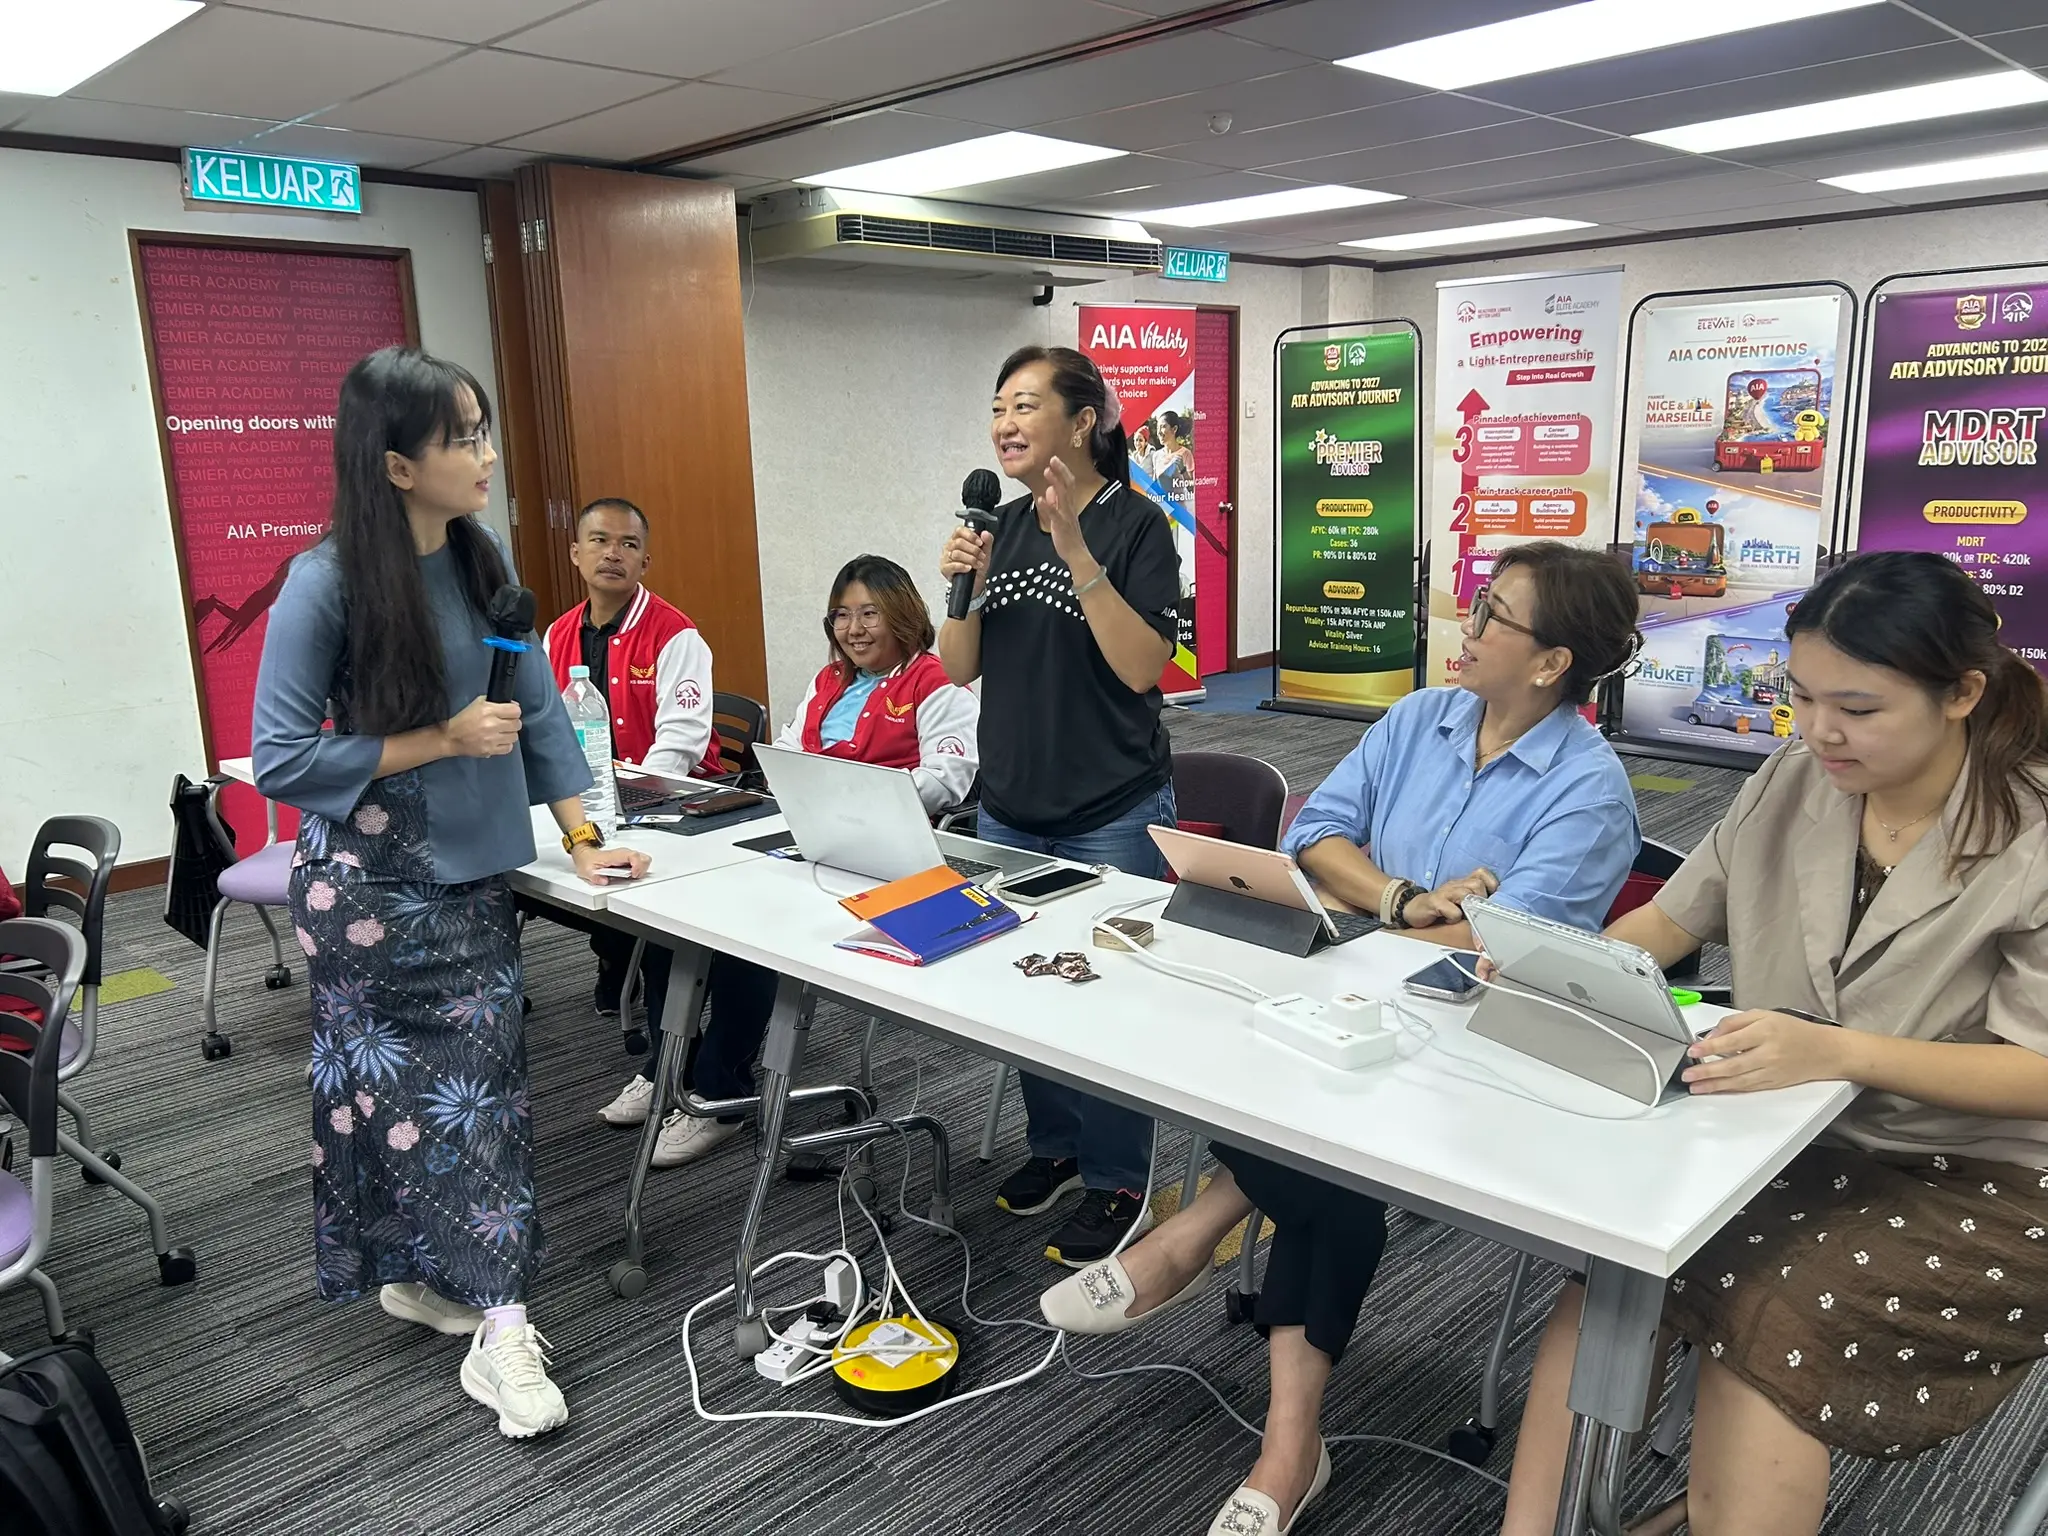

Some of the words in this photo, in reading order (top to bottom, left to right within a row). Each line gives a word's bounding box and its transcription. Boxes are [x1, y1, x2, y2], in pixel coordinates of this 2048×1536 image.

[195, 155, 324, 204] KELUAR
[202, 249, 277, 264] ACADEMY
[1167, 251, 1216, 278] KELUAR
[206, 276, 281, 292] ACADEMY
[290, 281, 355, 295] PREMIER
[1556, 295, 1572, 303] AIA
[1962, 300, 1981, 309] AIA
[1556, 302, 1571, 311] ELITE
[1572, 300, 1600, 310] ACADEMY
[210, 304, 284, 319] ACADEMY
[293, 308, 358, 321] PREMIER
[2003, 311, 2030, 323] AIA
[1697, 317, 1735, 331] ELEVATE
[214, 332, 287, 346] ACADEMY
[296, 334, 361, 348] PREMIER
[1090, 324, 1137, 349] AIA
[1140, 321, 1189, 358] Vitality
[1470, 324, 1583, 348] Empowering
[1726, 335, 1747, 344] 2026
[1668, 349, 1694, 363] AIA
[1697, 342, 1808, 361] CONVENTIONS
[1927, 343, 2000, 358] ADVANCING
[2002, 340, 2019, 353] TO
[2022, 338, 2048, 352] 202
[1457, 359, 1464, 367] a
[1469, 350, 1594, 368] Light-Entrepreneurship
[217, 360, 291, 373] ACADEMY
[1097, 365, 1118, 374] tively
[1119, 364, 1153, 375] supports
[1154, 364, 1169, 373] and
[1889, 361, 1922, 379] AIA
[1922, 357, 2010, 378] ADVISORY
[2011, 354, 2048, 374] JOU
[1122, 378, 1136, 388] you
[1137, 376, 1147, 385] for
[1149, 376, 1177, 387] making
[1516, 374, 1531, 382] Step
[1545, 372, 1559, 380] Real
[1561, 371, 1584, 379] Growth
[1311, 380, 1350, 391] ADVANCING
[1351, 379, 1361, 389] TO
[1362, 377, 1380, 388] 2027
[1750, 383, 1765, 392] AIA
[221, 387, 295, 400] ACADEMY
[1119, 388, 1148, 398] choices
[1291, 394, 1309, 408] AIA
[1309, 391, 1356, 407] ADVISORY
[1357, 388, 1401, 404] JOURNEY
[1646, 400, 1675, 412] NICE
[1677, 402, 1684, 410] &
[1474, 414, 1510, 424] Pinnacle
[1512, 414, 1521, 423] of
[1524, 412, 1580, 422] achievement
[1645, 411, 1713, 424] MARSEILLE
[166, 416, 244, 433] Opening
[249, 416, 299, 430] doors
[1924, 408, 2045, 442] MDRT
[229, 440, 301, 452] ACADEMY
[1453, 426, 1473, 462] 3
[1317, 441, 1382, 464] PREMIER
[1918, 440, 2038, 466] ADVISOR
[233, 467, 304, 479] ACADEMY
[1331, 464, 1370, 476] ADVISOR
[1172, 478, 1194, 488] Know
[1195, 476, 1218, 487] cademy
[1168, 491, 1195, 502] Health
[1474, 486, 1520, 496] Twin-track
[1521, 488, 1551, 496] career
[1552, 486, 1573, 497] path
[236, 493, 307, 506] ACADEMY
[1321, 503, 1368, 512] PRODUCTIVITY
[1450, 494, 1472, 532] 2
[1933, 506, 2017, 518] PRODUCTIVITY
[227, 525, 257, 539] AIA
[262, 522, 323, 537] Premier
[1311, 525, 1327, 534] AFYC:
[1328, 526, 1339, 535] 60k
[1347, 526, 1361, 535] TPC:
[1363, 526, 1379, 535] 280k
[1330, 539, 1349, 547] Cases:
[1350, 539, 1358, 548] 36
[1956, 536, 1986, 547] MDRT
[1323, 550, 1337, 559] 90%
[1352, 551, 1366, 560] 80%
[1740, 550, 1800, 564] PERTH
[1964, 554, 1975, 563] OR
[1976, 553, 2000, 564] TPC:
[2003, 554, 2031, 565] 420k
[1452, 559, 1466, 597] 1
[1979, 569, 1993, 579] 36
[1328, 585, 1359, 595] ADVISORY
[1982, 584, 2007, 595] 80%
[2009, 585, 2024, 596] D2
[1285, 603, 1319, 613] Repurchase:
[1320, 605, 1333, 614] 10%
[1341, 606, 1352, 615] 30k
[1353, 607, 1368, 616] AFYC
[1377, 609, 1391, 618] 150k
[1392, 609, 1406, 619] ANP
[1304, 616, 1325, 626] Vitality:
[1326, 617, 1337, 626] 15k
[1338, 618, 1353, 628] AFYC
[1361, 620, 1372, 629] 75k
[1373, 620, 1386, 629] ANP
[1325, 630, 1345, 641] Vitality
[1346, 631, 1363, 640] Silver
[1309, 640, 1329, 649] Advisor
[1330, 641, 1352, 652] Training
[1353, 644, 1371, 652] Hours:
[1373, 645, 1380, 653] 16
[2020, 648, 2047, 660] 150k
[677, 698, 701, 709] AIA
